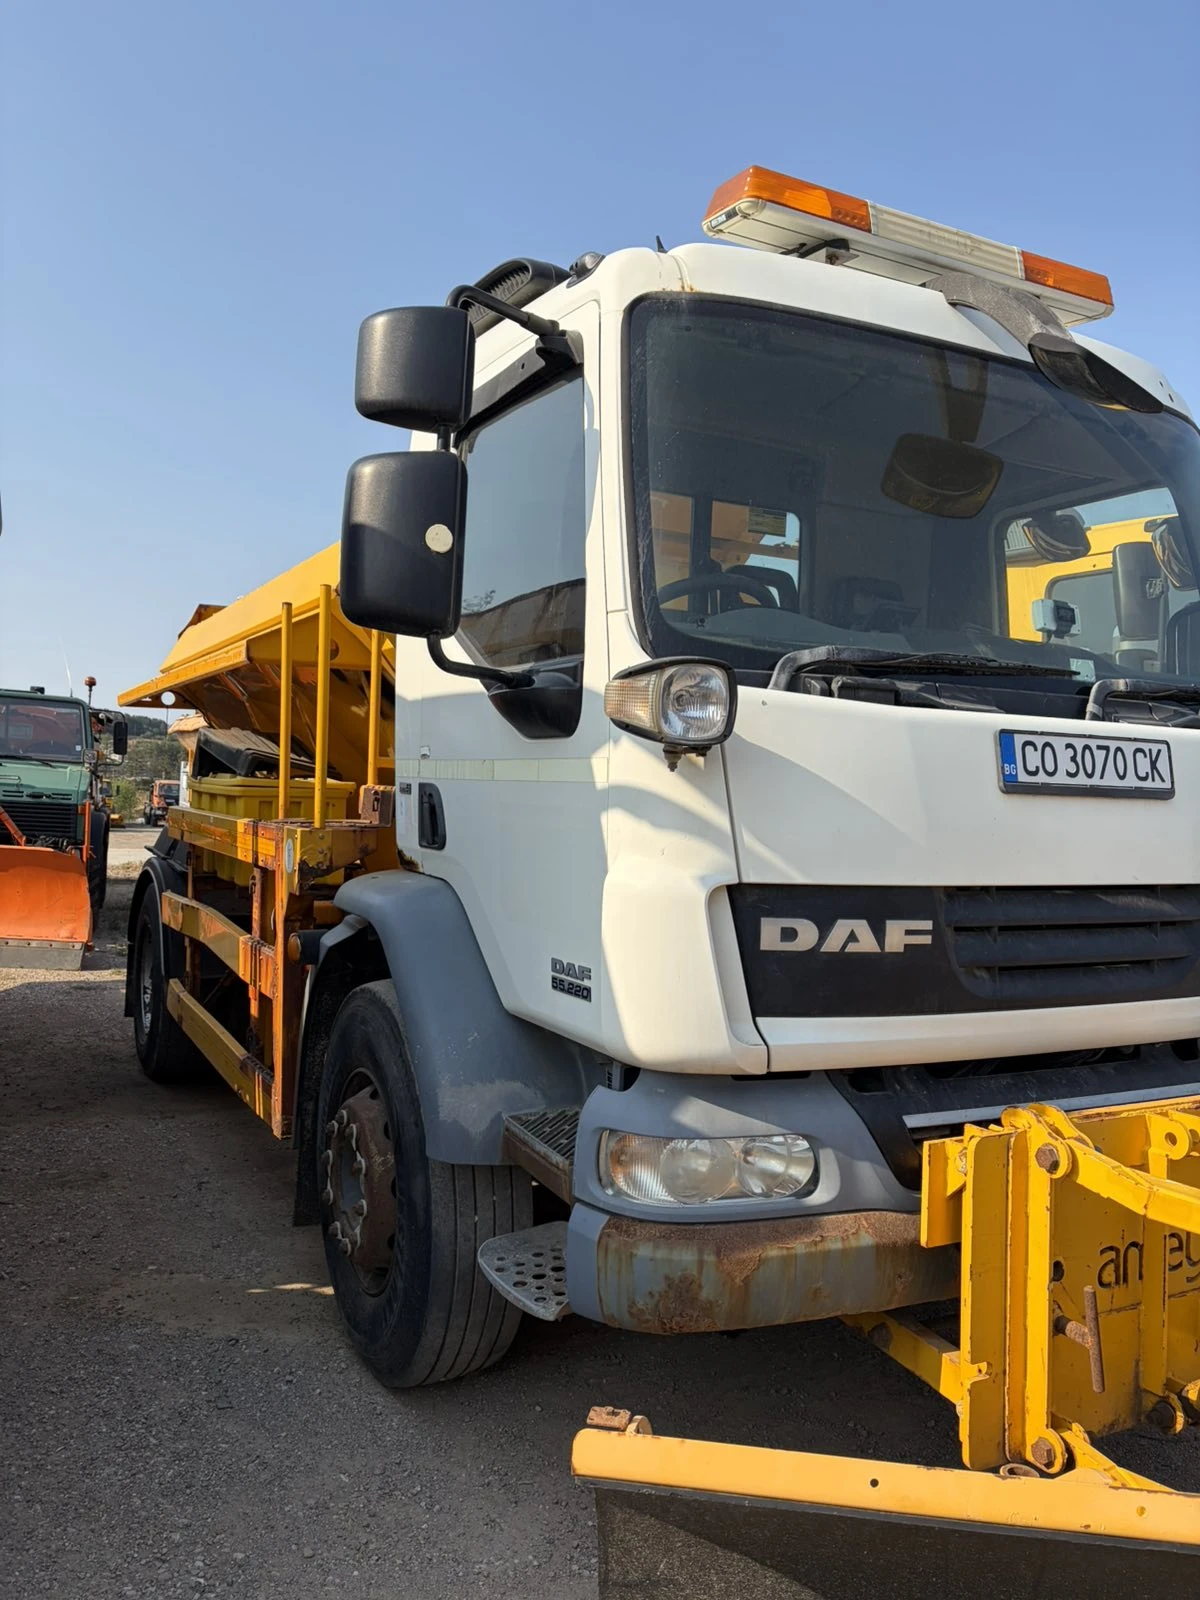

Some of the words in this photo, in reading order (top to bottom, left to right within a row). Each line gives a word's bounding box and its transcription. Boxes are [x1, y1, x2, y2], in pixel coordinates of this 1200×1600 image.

[1004, 763, 1017, 775] BG
[1021, 739, 1059, 777] CO
[1064, 742, 1128, 781] 3070
[1132, 747, 1167, 783] CK
[759, 916, 934, 953] DAF
[551, 957, 592, 982] DAF
